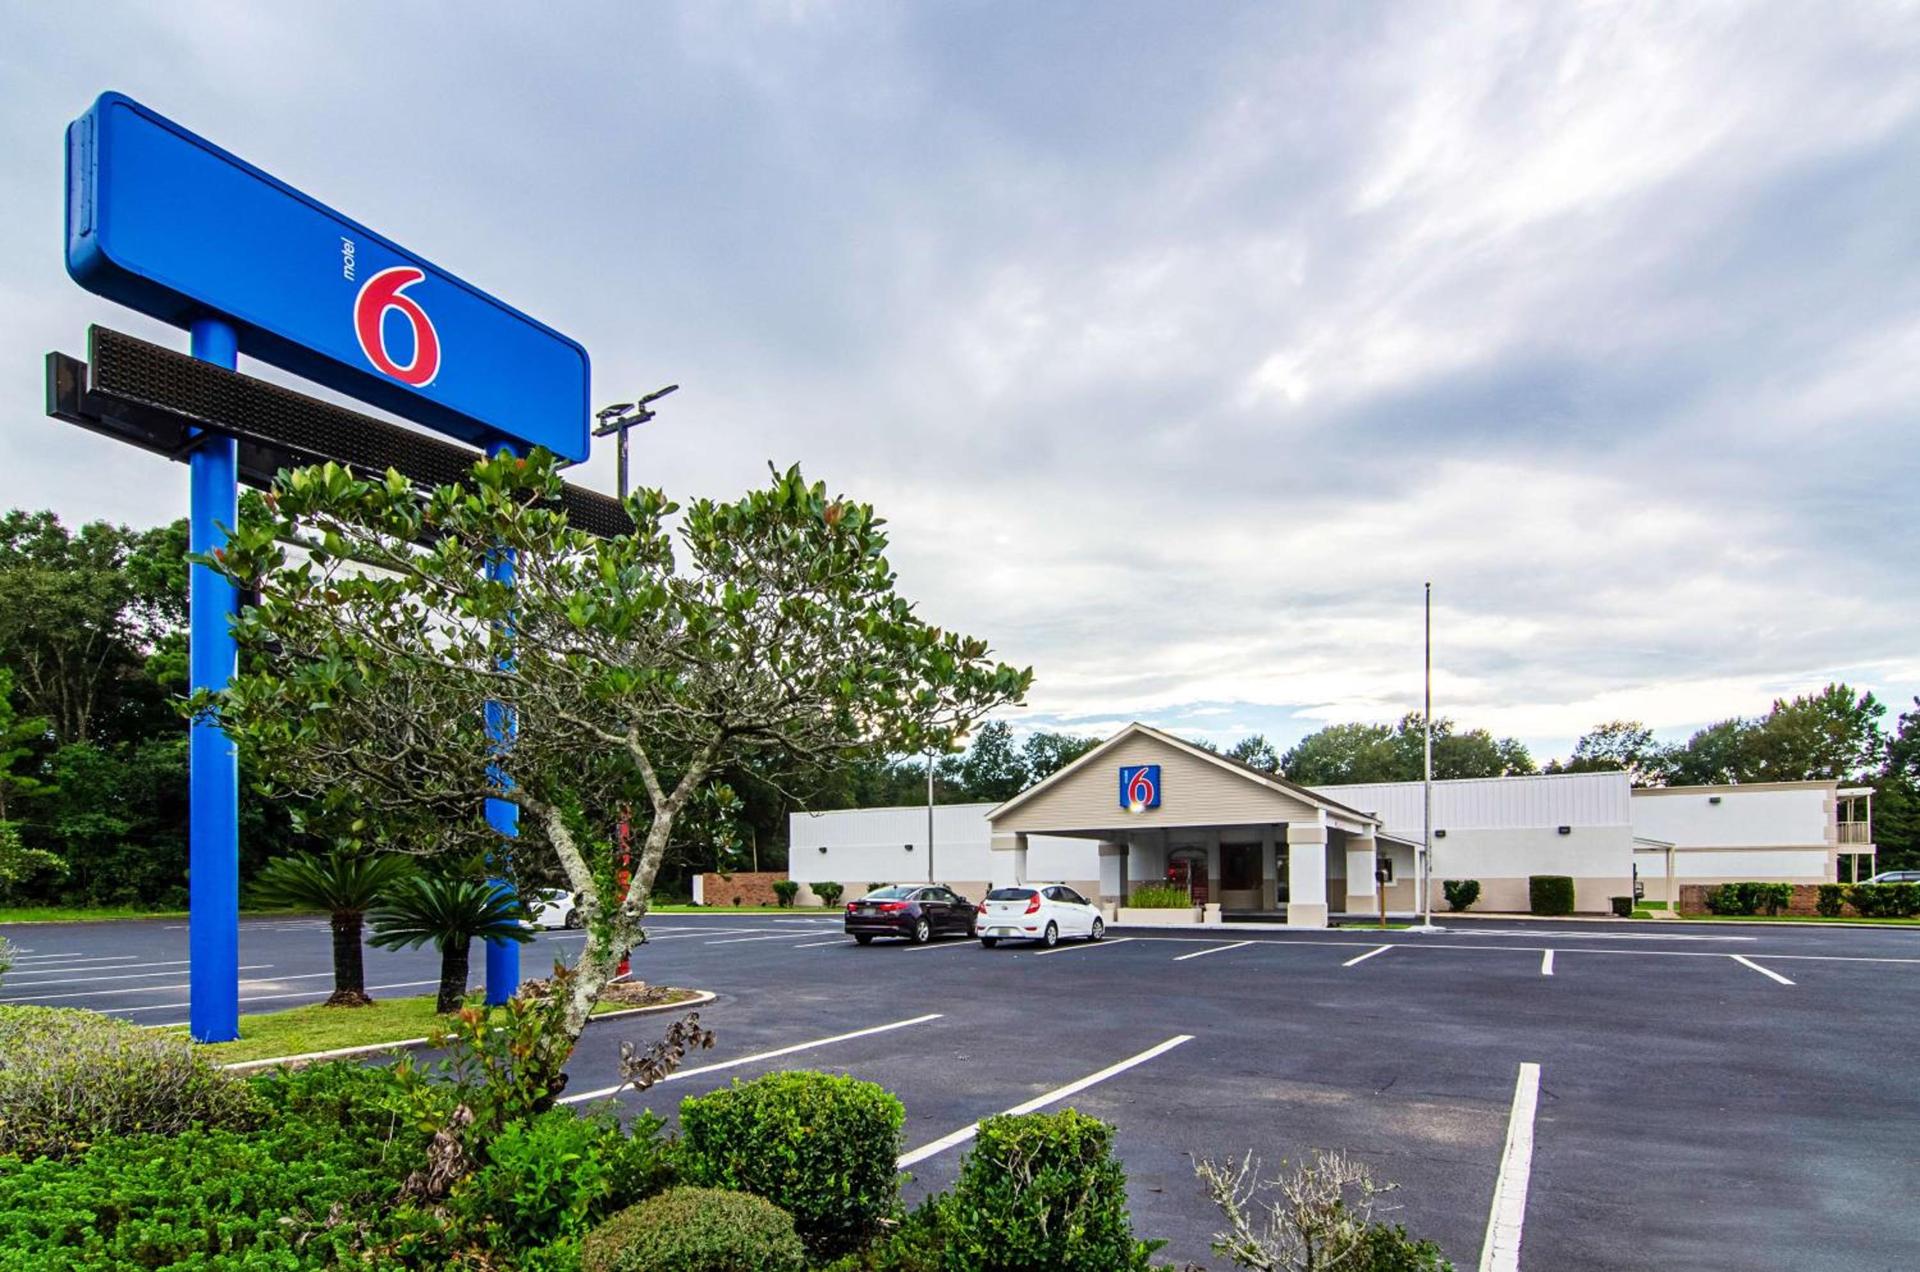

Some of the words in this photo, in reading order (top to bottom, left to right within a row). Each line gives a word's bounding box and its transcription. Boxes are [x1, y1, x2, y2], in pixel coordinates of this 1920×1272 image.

[340, 236, 355, 282] motel
[353, 265, 441, 388] 6
[1128, 767, 1155, 808] 6
